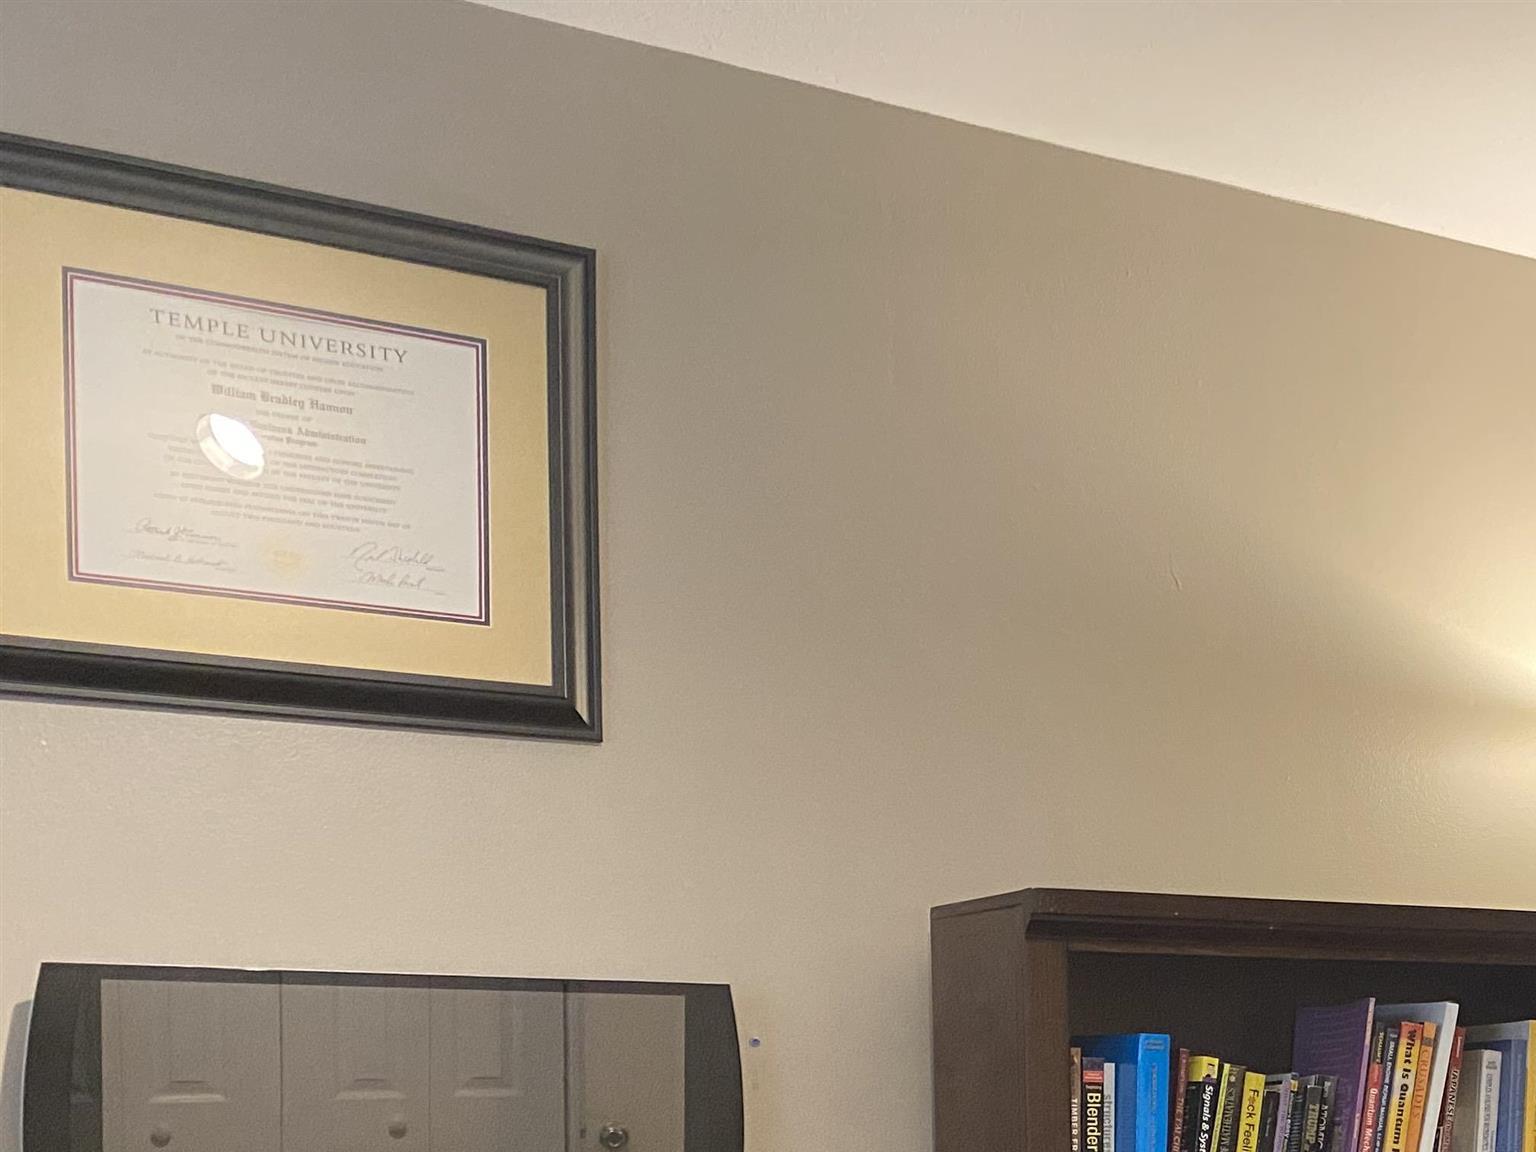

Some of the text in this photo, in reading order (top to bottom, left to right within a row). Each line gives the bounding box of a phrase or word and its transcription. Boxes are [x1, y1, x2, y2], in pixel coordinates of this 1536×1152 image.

[149, 308, 250, 340] TEMPLE
[260, 328, 409, 364] UNIVERSITY
[1386, 1040, 1395, 1061] SMALL
[1403, 1030, 1416, 1064] What
[1383, 1062, 1392, 1083] ENGINE
[1401, 1068, 1410, 1079] Is
[1411, 1048, 1429, 1120] CRUSADES
[1201, 1084, 1213, 1120] Signals
[1365, 1087, 1378, 1126] Quantum
[1380, 1084, 1389, 1105] REPAIR
[1446, 1069, 1459, 1120] JAPANESE
[1086, 1092, 1101, 1152] Blender
[1201, 1122, 1209, 1131] &
[1219, 1087, 1237, 1145] MATHEMATICS
[1305, 1103, 1319, 1144] TRUMP
[1376, 1106, 1385, 1132] MANUAL
[1392, 1083, 1408, 1145] Quantum
